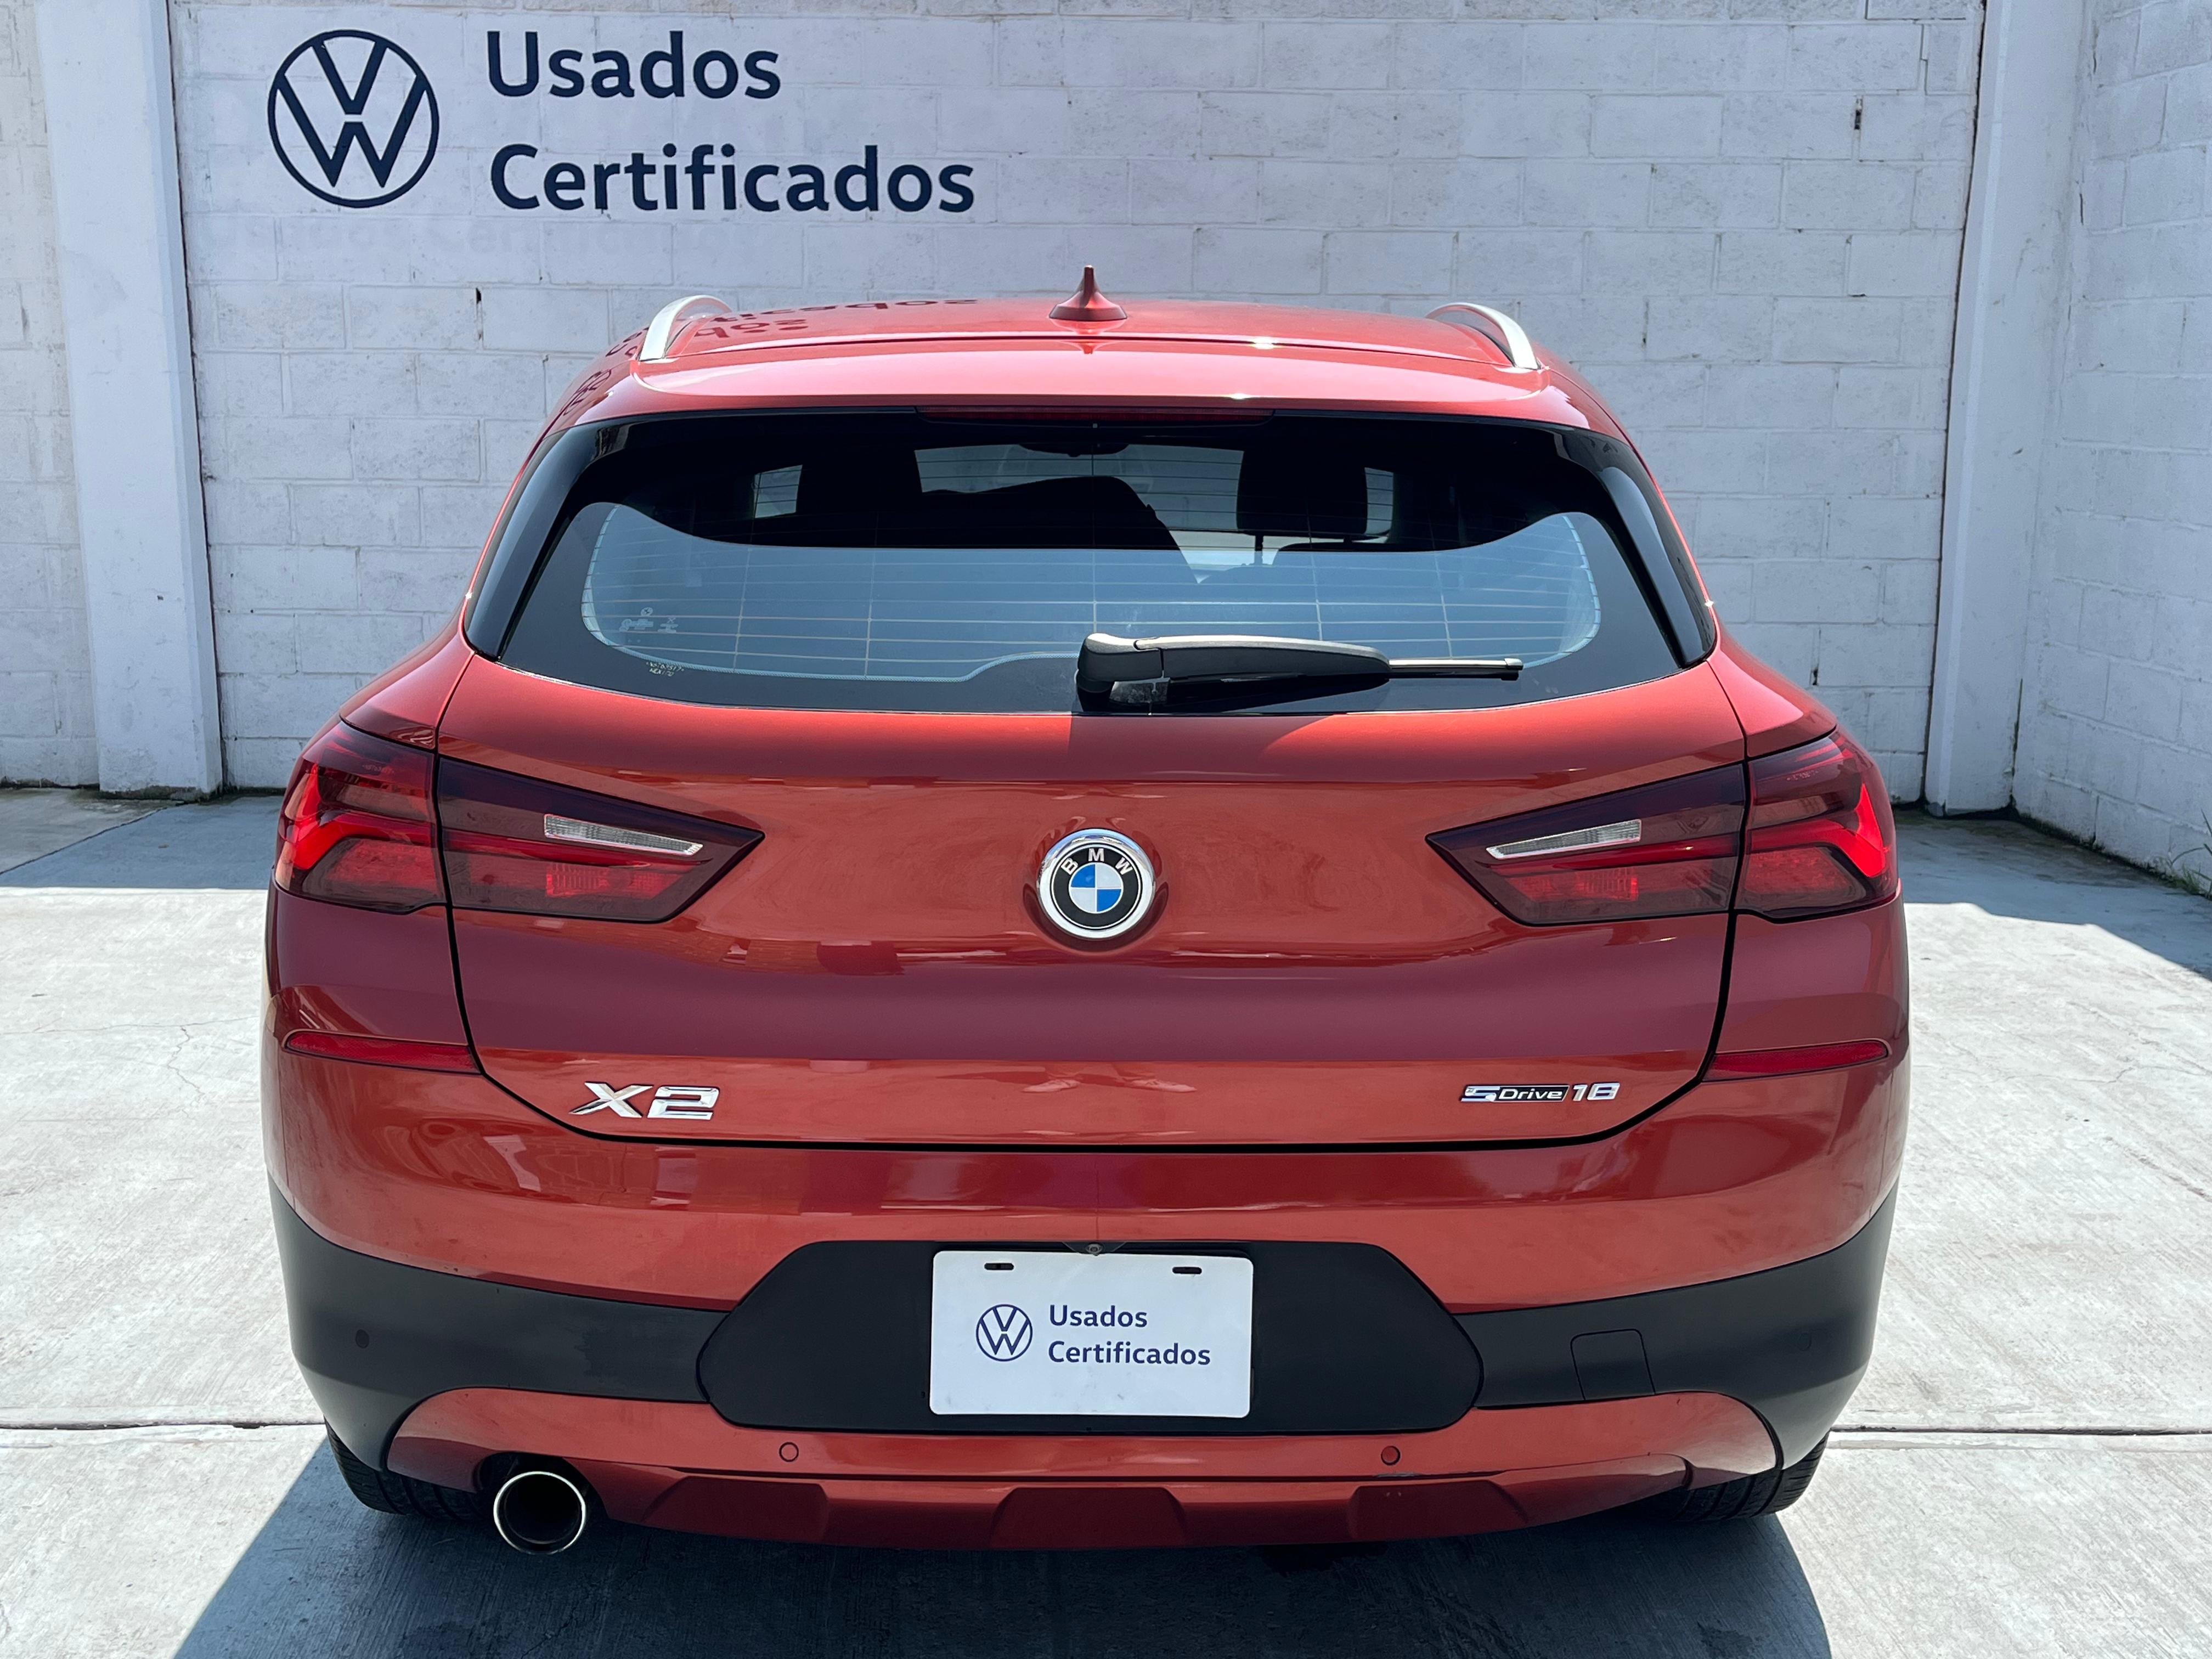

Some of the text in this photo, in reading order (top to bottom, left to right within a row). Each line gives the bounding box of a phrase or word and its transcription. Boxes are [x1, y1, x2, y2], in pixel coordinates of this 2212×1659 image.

[487, 30, 781, 99] Usados
[490, 143, 974, 213] Certificados
[1060, 848, 1133, 876] BMW
[569, 1081, 720, 1120] X2
[1572, 1082, 1621, 1102] 18
[1049, 1304, 1148, 1328] Usados
[1048, 1340, 1211, 1365] Certificados
